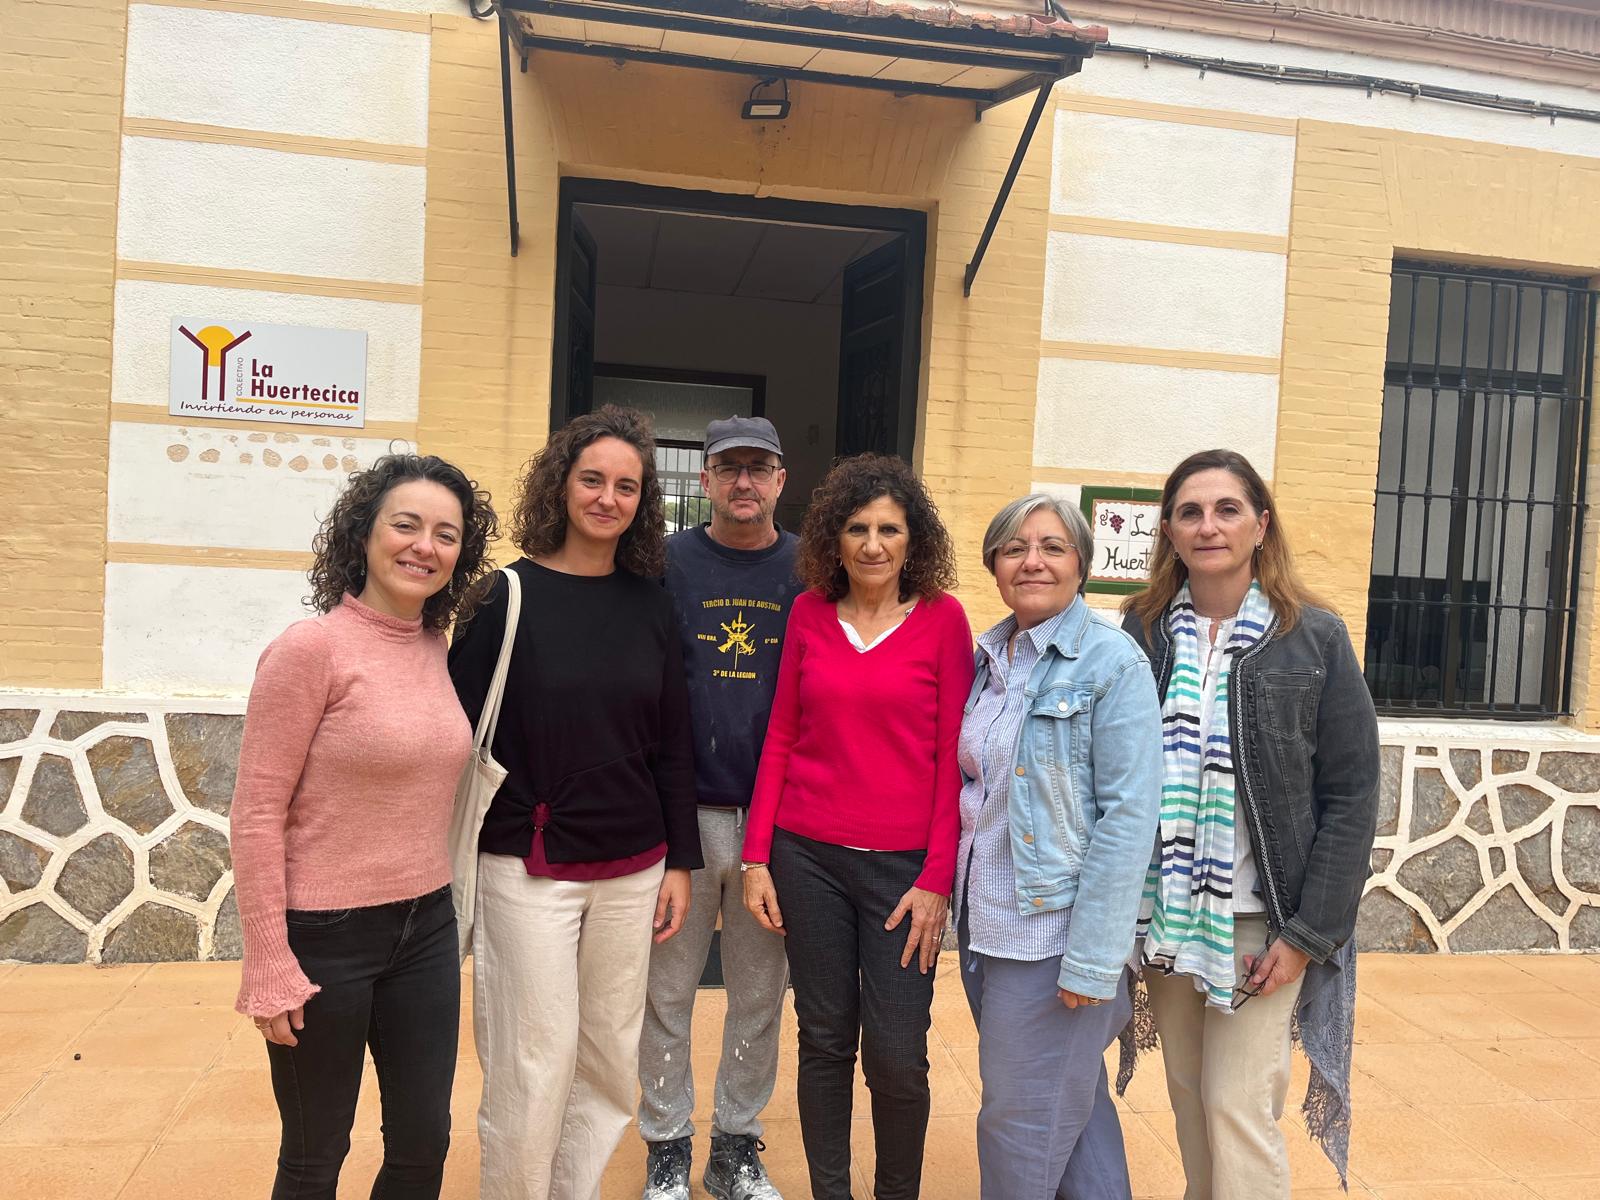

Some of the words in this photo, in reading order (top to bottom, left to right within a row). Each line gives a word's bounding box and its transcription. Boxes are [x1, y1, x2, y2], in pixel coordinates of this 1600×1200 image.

[236, 357, 244, 396] COLECTIVO
[252, 359, 273, 378] La
[251, 379, 359, 403] Huertecica
[180, 401, 265, 415] Invirtiendo
[269, 407, 287, 416] en
[291, 410, 353, 421] personas
[1102, 546, 1151, 571] Huert
[702, 599, 724, 609] TERCIO
[732, 598, 747, 607] JUAN
[748, 599, 756, 607] DE
[756, 600, 782, 612] AUSTRIA
